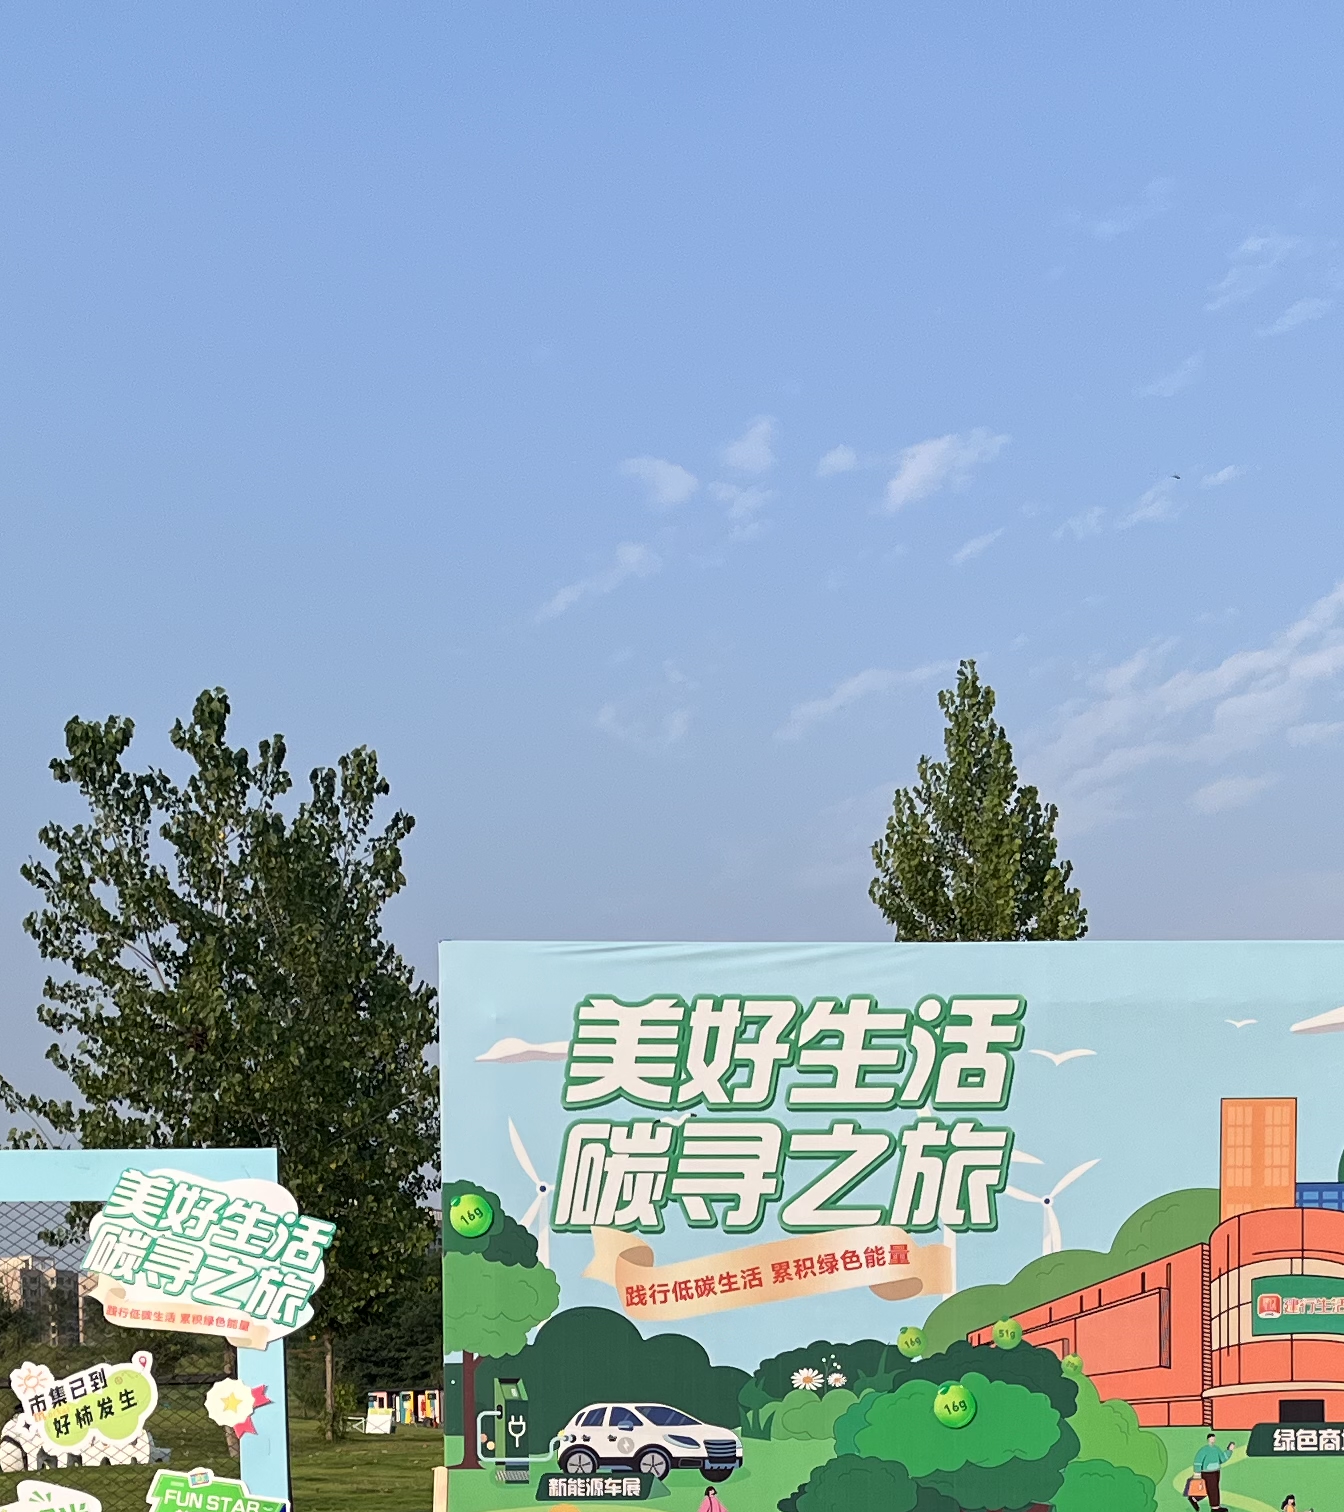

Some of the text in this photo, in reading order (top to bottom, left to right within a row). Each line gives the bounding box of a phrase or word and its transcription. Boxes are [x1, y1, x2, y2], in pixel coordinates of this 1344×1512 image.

[561, 994, 1027, 1110] 美好生活
[551, 1118, 1014, 1233] 碳寻之旅
[103, 1168, 337, 1273] 美好生活
[460, 1207, 483, 1225] 16g
[80, 1222, 316, 1327] 碳寻之旅
[625, 1244, 911, 1307] 践行低碳生活 累积绿色能量
[904, 1336, 922, 1349] 16g
[28, 1368, 108, 1415] 市集已到
[53, 1388, 138, 1438] 好柿发生
[943, 1399, 968, 1415] 16g
[164, 1489, 203, 1509] FUN
[548, 1477, 641, 1497] 新能源车展
